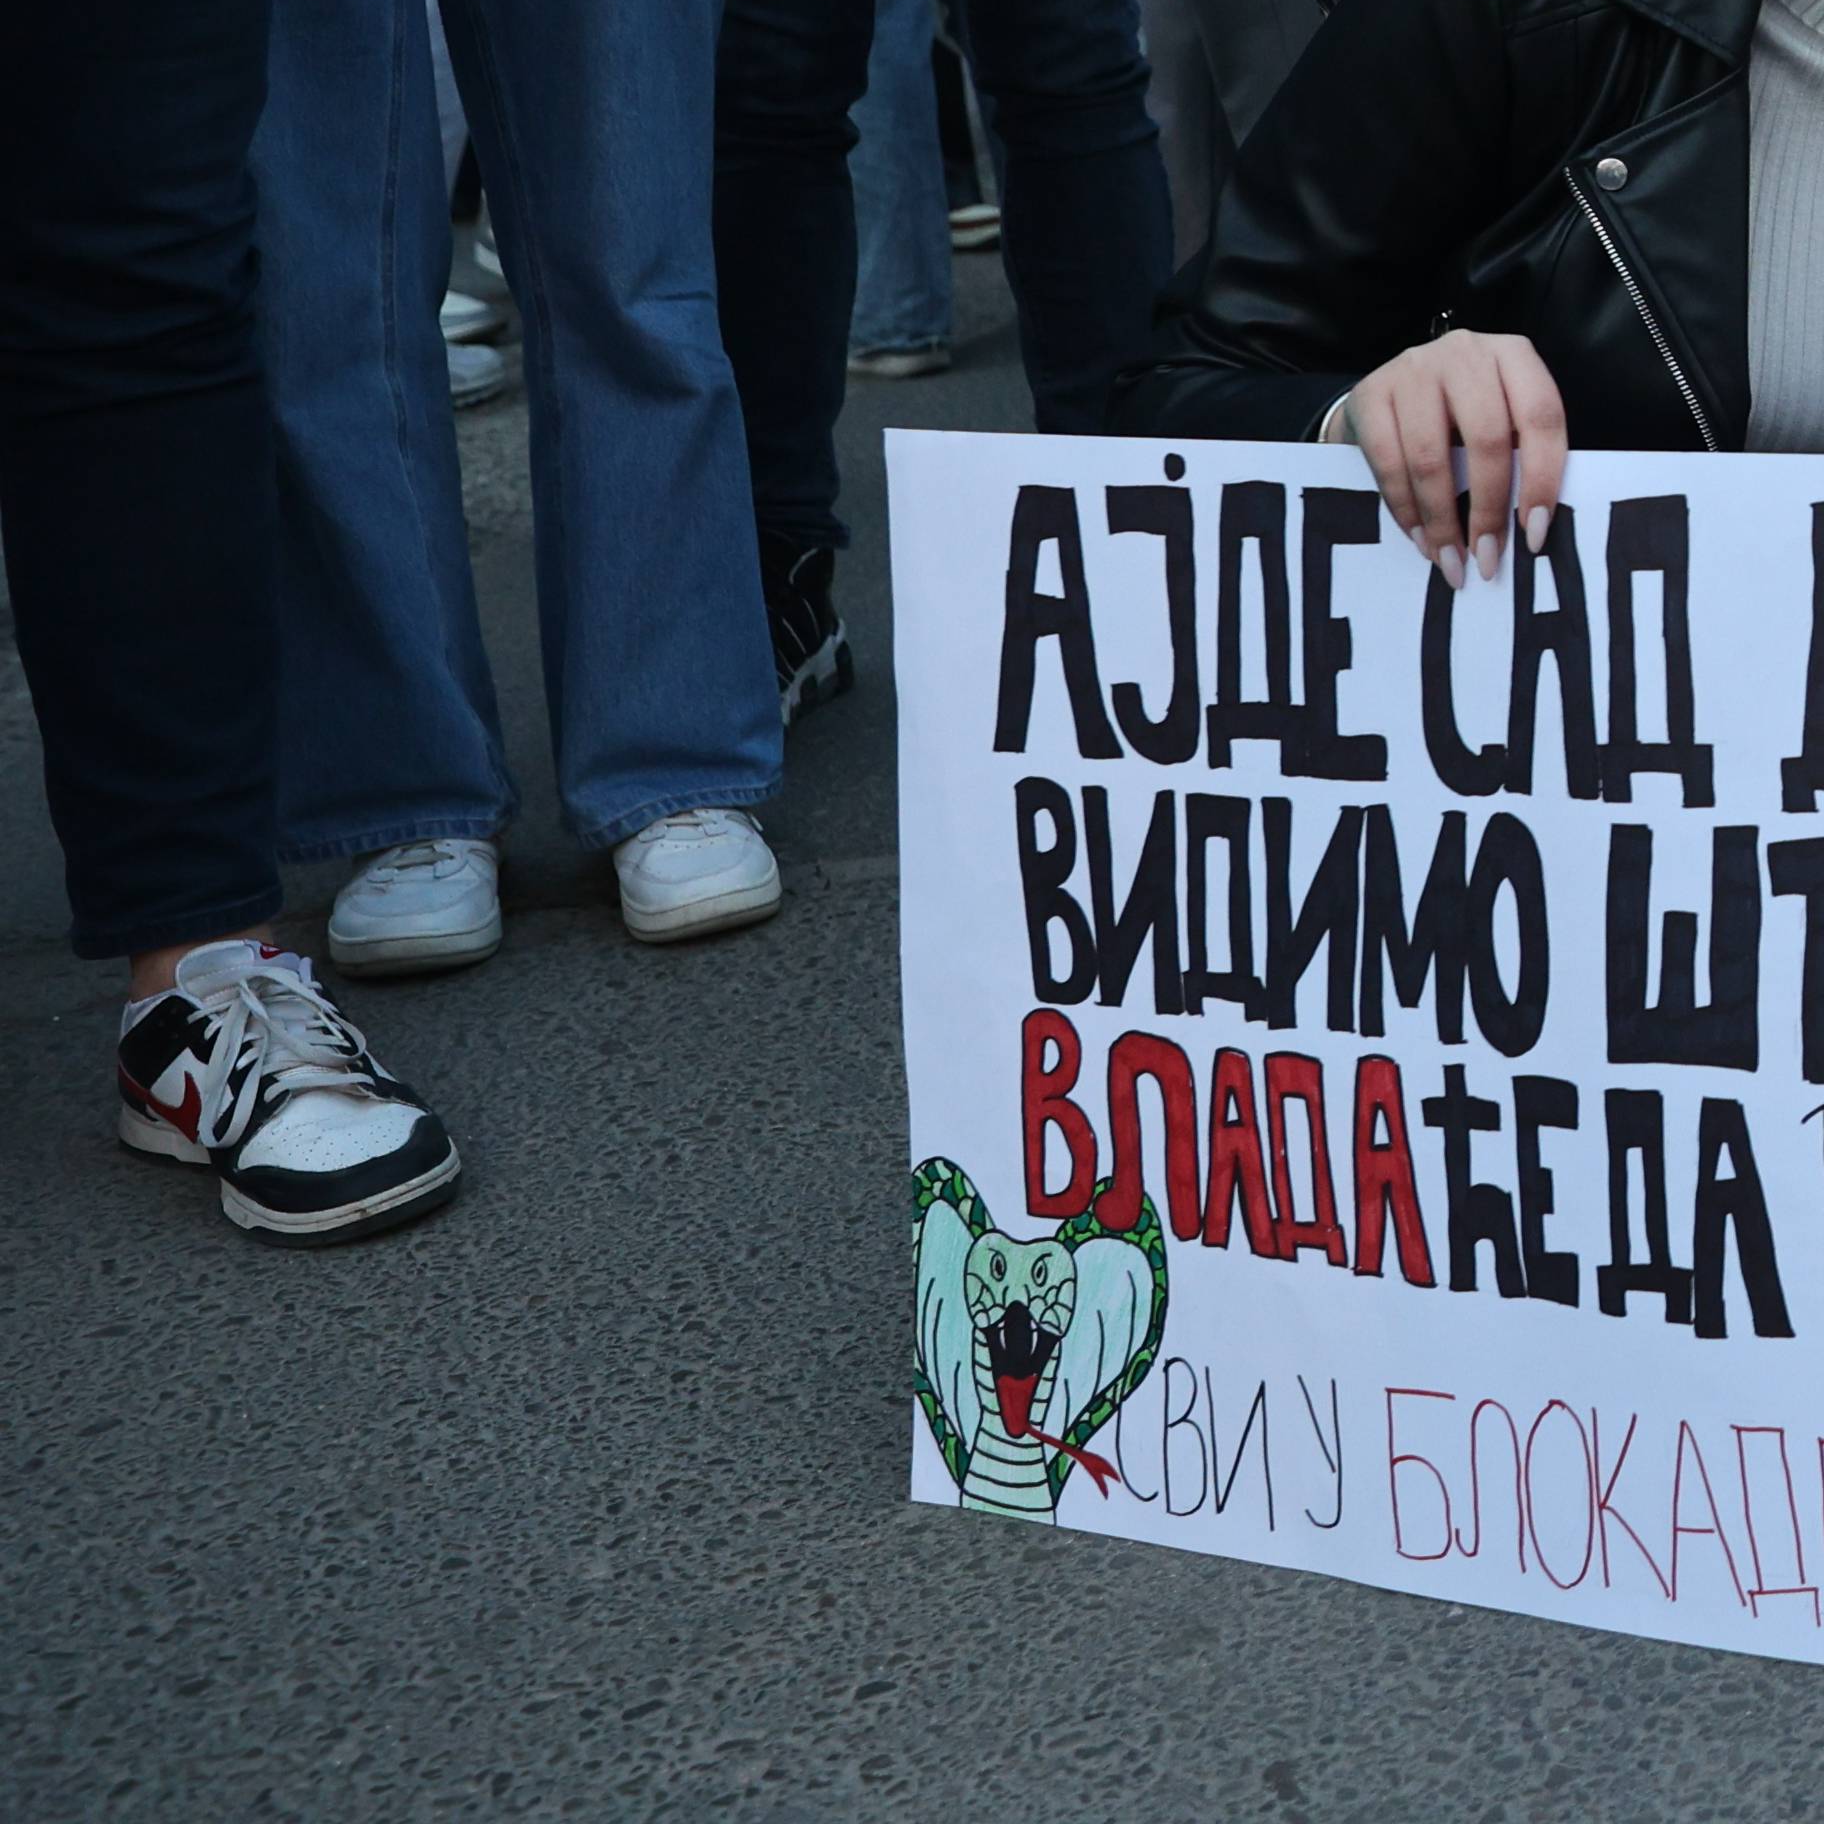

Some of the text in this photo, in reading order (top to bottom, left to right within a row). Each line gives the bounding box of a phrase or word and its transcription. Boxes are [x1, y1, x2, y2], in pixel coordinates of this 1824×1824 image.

[993, 453, 1388, 782] АЈДЕ
[1420, 488, 1716, 810] САД
[1013, 777, 1549, 1057] ВИДИМО
[1021, 1007, 1435, 1288] ВЛАДА
[1422, 1063, 1580, 1307] ЋЕ
[1596, 1088, 1794, 1340] ДА
[1297, 1374, 1343, 1529] У
